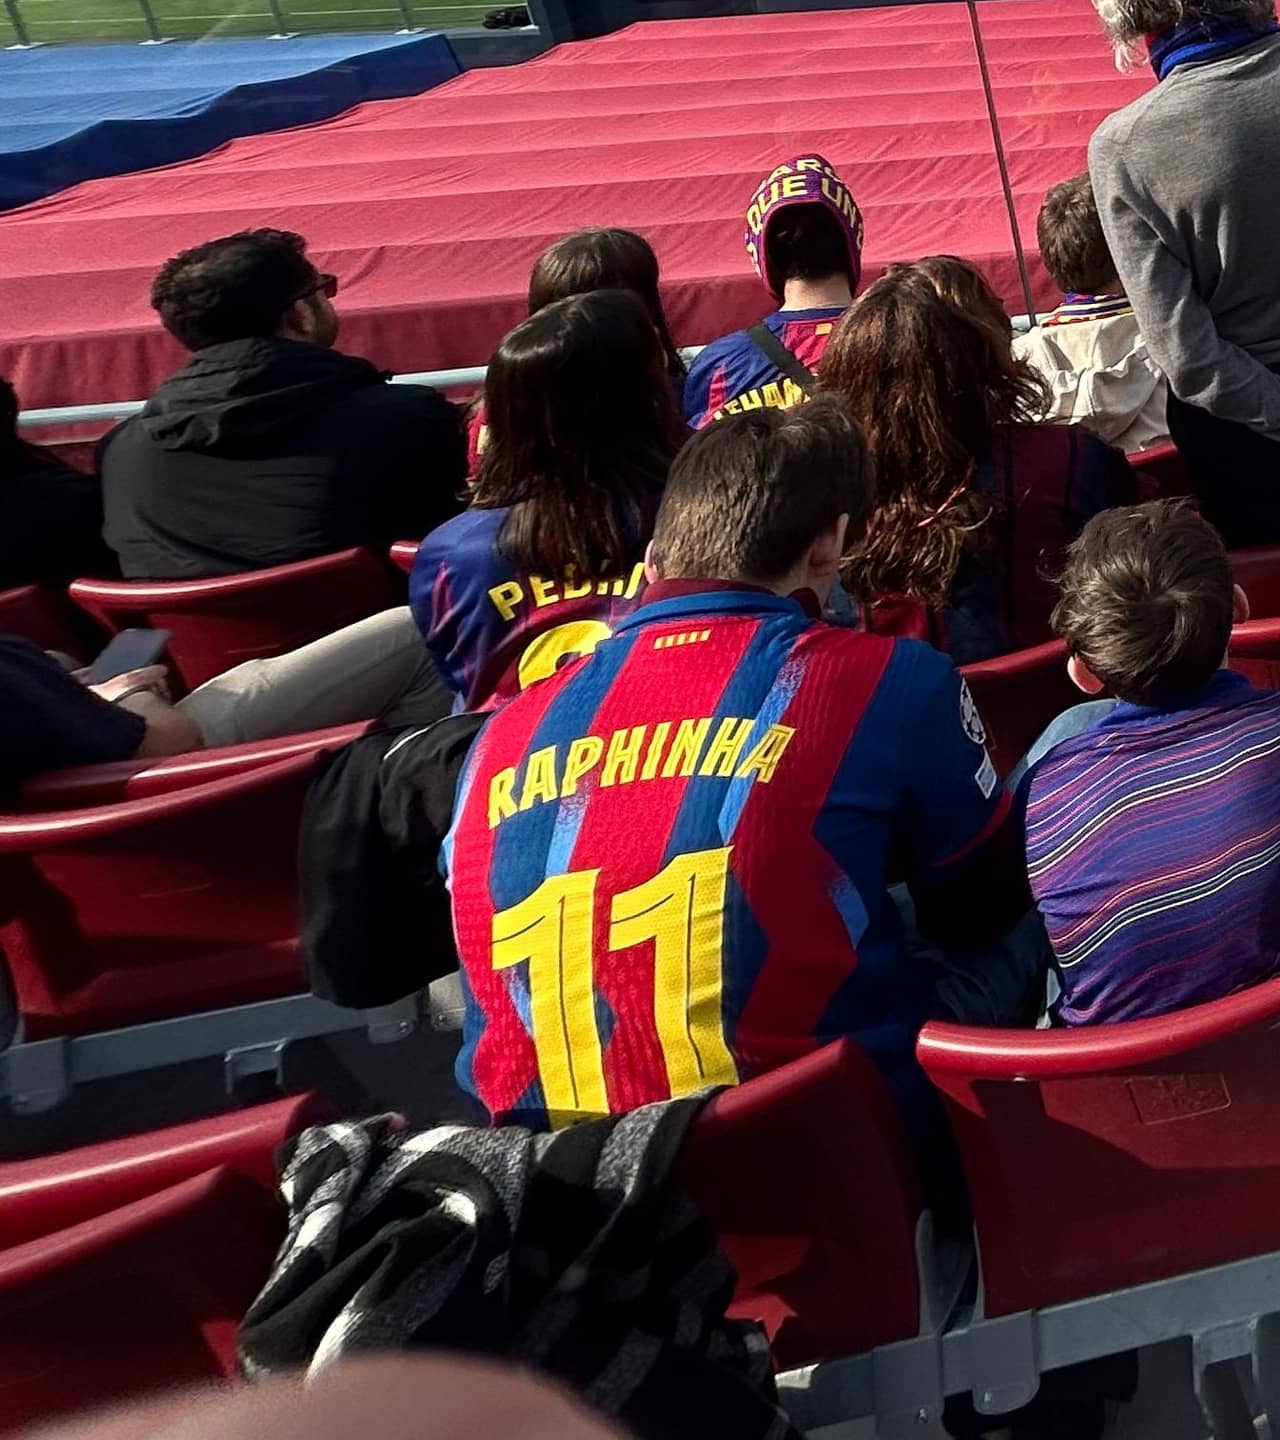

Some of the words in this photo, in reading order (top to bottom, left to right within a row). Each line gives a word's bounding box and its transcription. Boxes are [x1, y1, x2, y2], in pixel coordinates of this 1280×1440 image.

[746, 174, 808, 236] QUE
[488, 716, 796, 830] RAPHINHA
[491, 845, 740, 1139] 11
